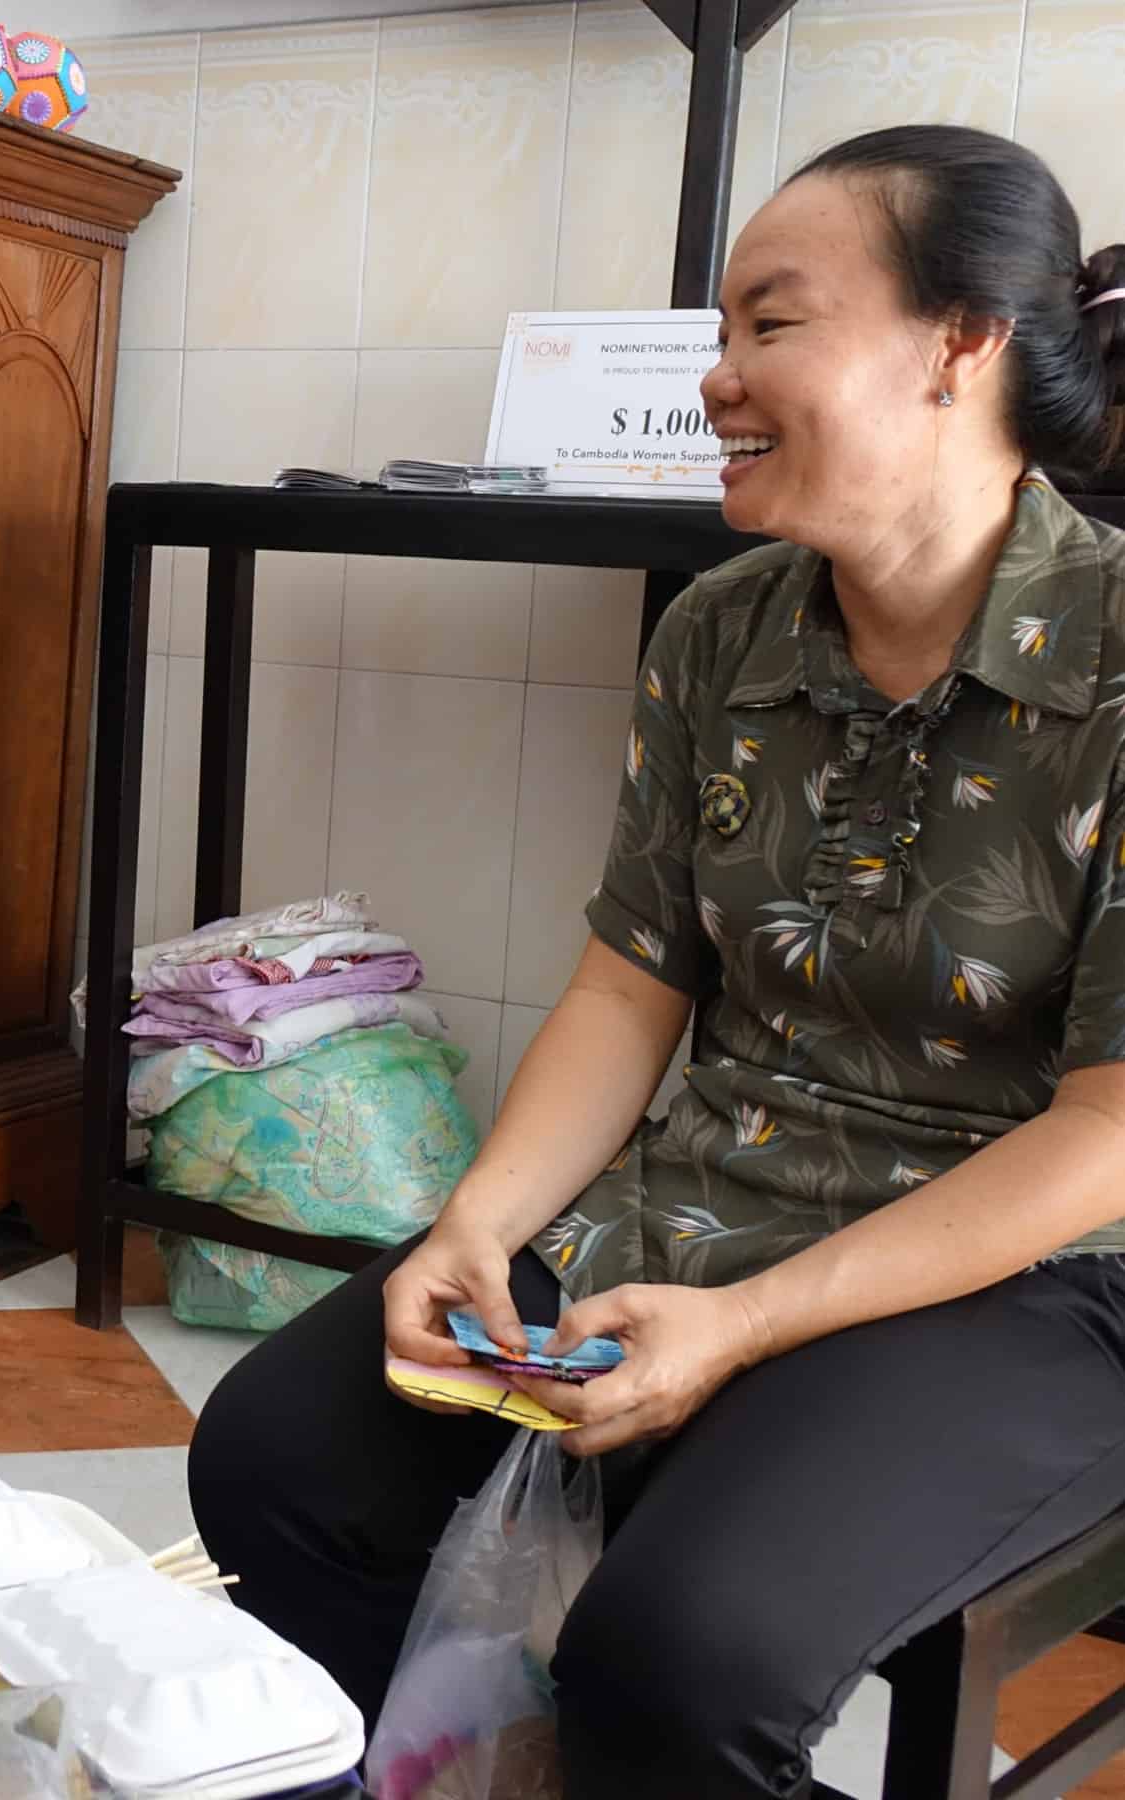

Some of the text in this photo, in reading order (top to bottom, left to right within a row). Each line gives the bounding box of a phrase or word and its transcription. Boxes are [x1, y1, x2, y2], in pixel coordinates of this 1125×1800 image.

[600, 343, 689, 353] NOMINETWORK
[612, 367, 640, 376] PROUD
[642, 367, 653, 376] TO
[610, 407, 628, 436] $
[555, 447, 569, 458] To
[571, 447, 629, 460] Cambodia
[633, 449, 676, 461] Women
